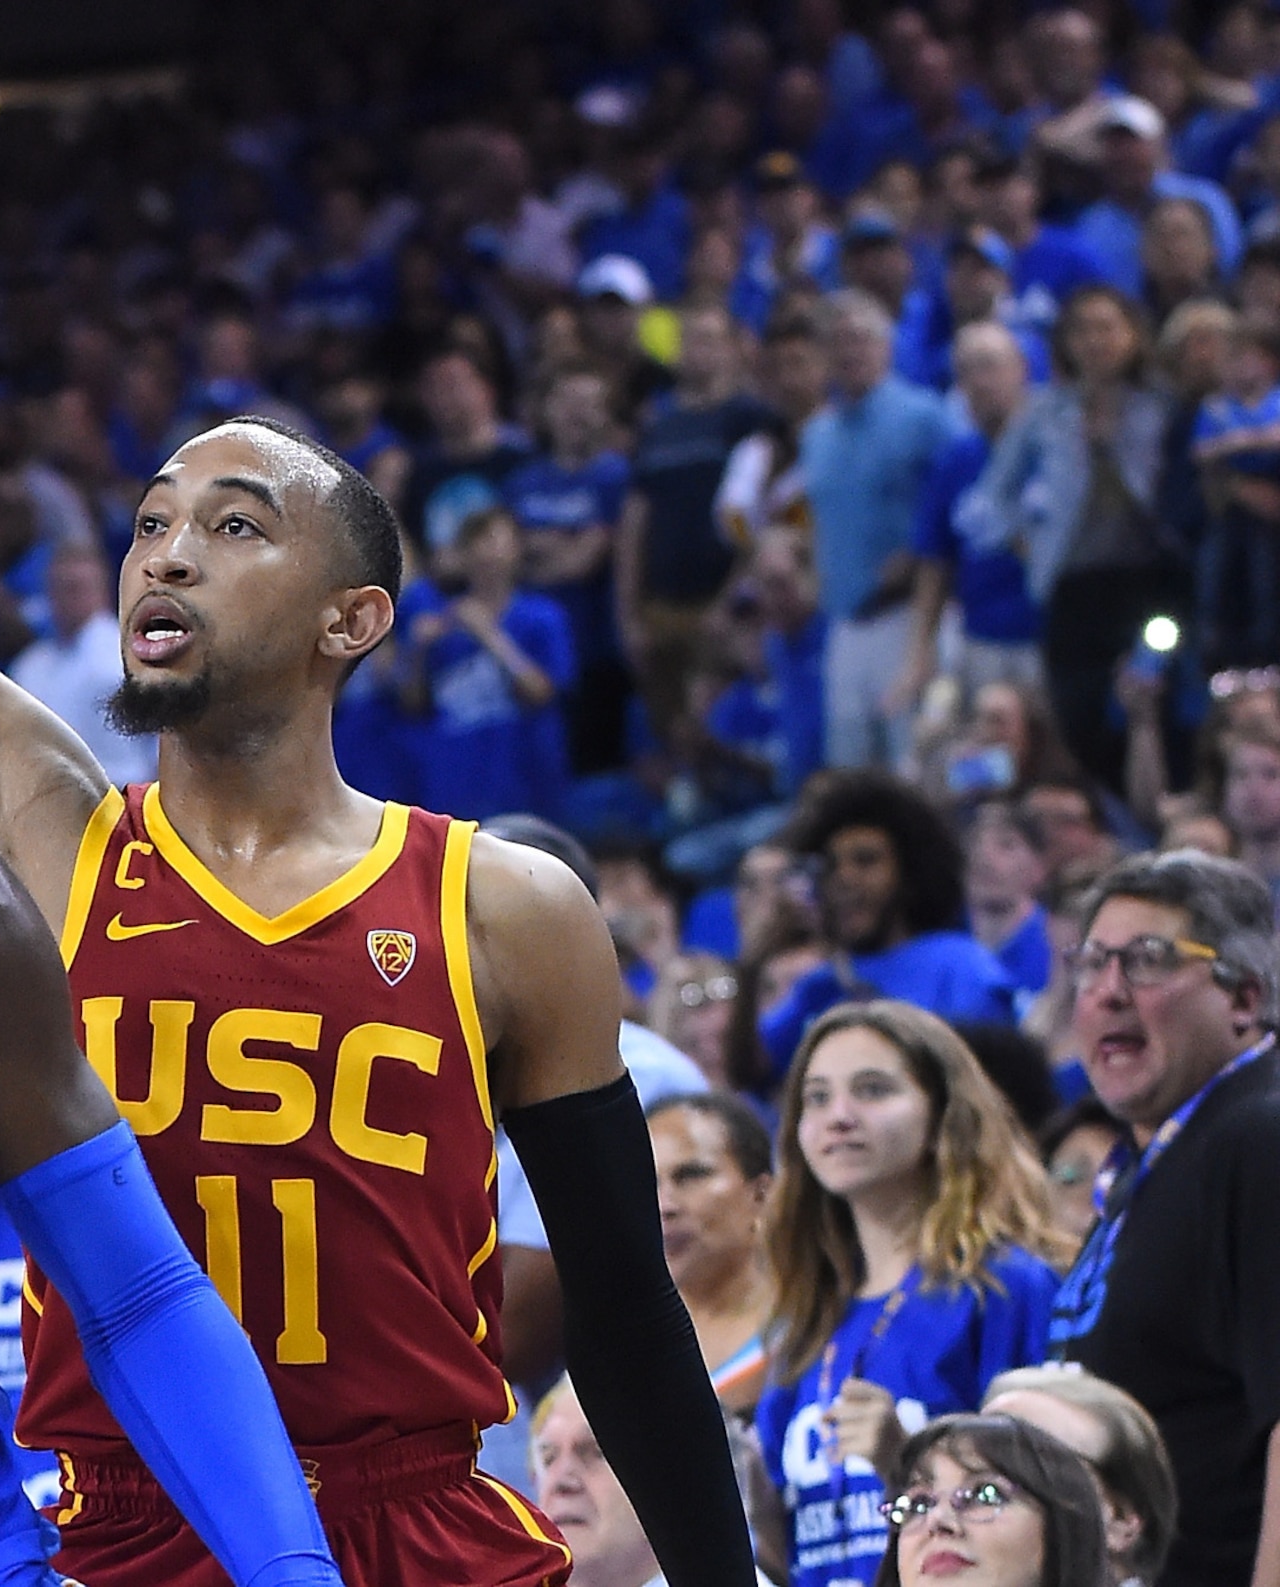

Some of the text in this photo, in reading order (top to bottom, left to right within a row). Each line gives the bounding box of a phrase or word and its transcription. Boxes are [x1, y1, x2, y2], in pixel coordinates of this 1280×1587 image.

[115, 840, 154, 890] C
[372, 933, 411, 963] PAC
[382, 952, 402, 973] 12
[82, 996, 443, 1175] USC
[196, 1175, 327, 1364] 11
